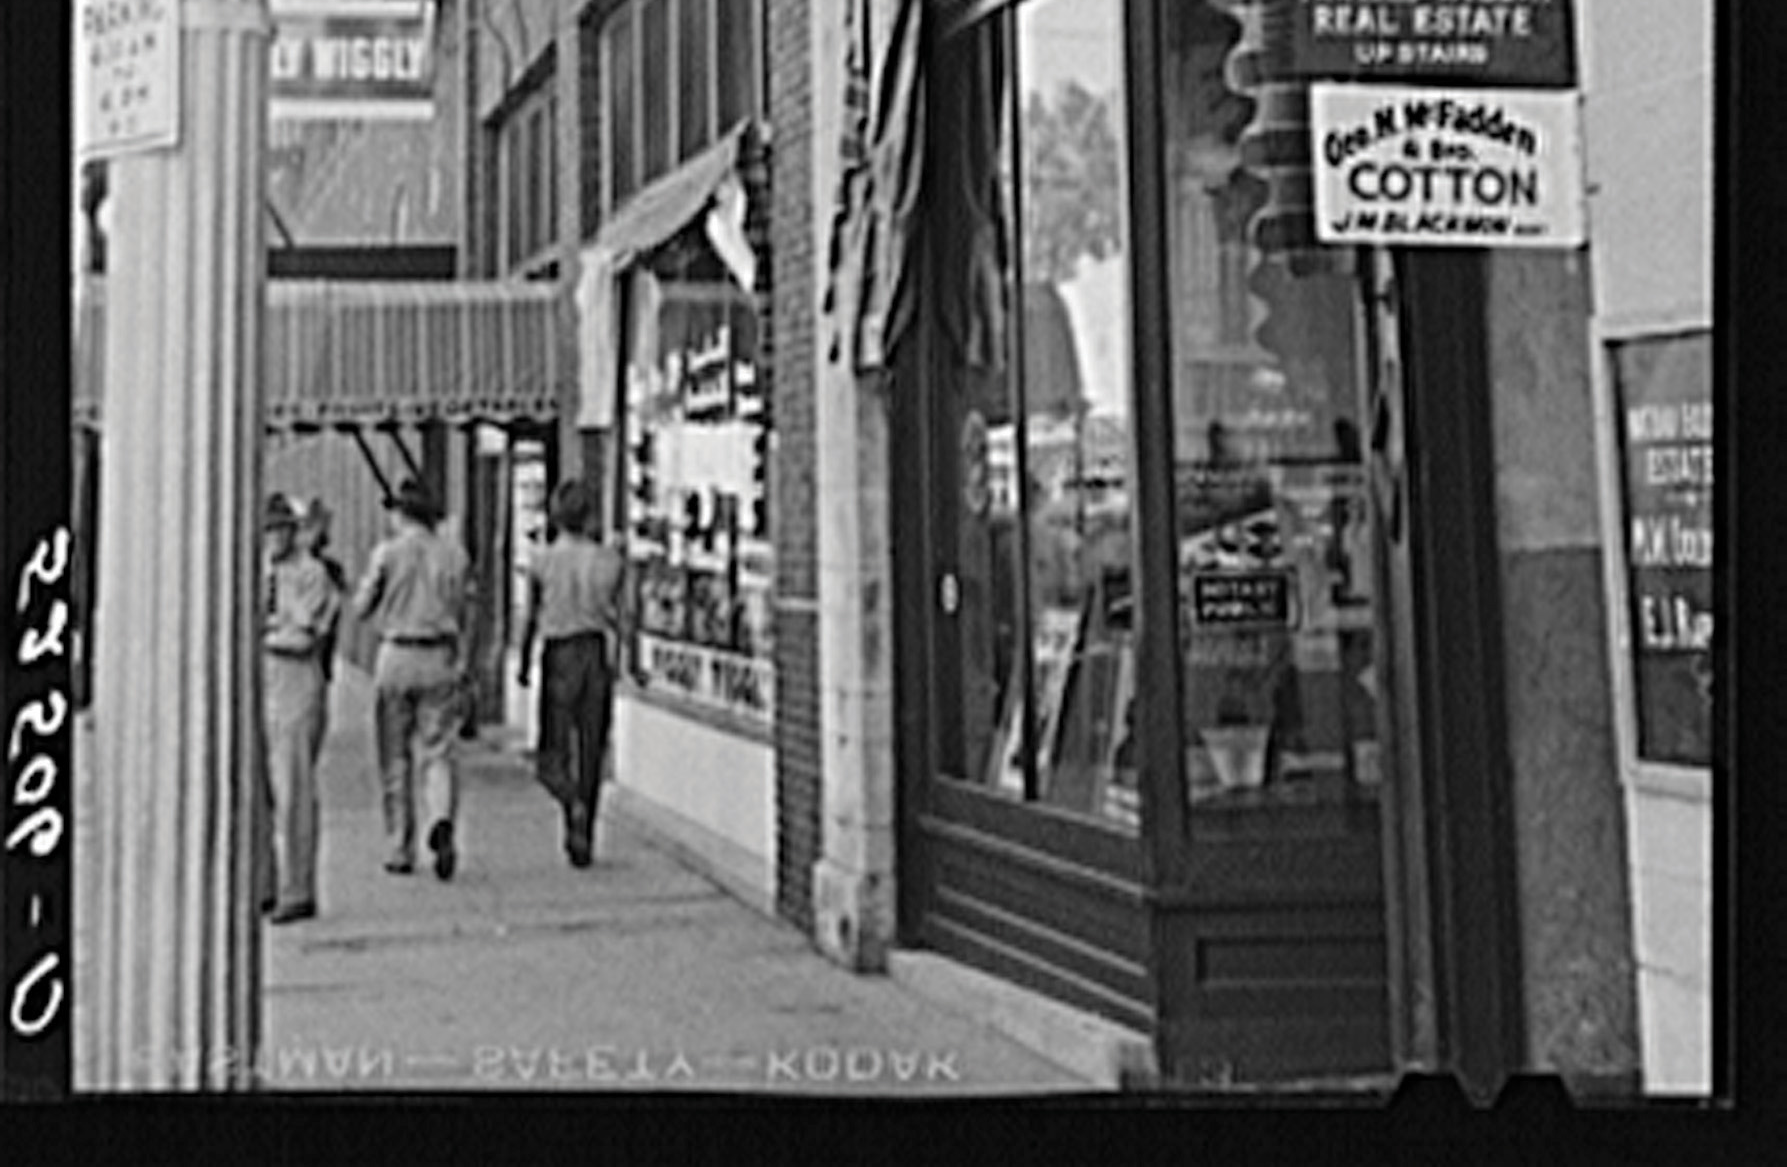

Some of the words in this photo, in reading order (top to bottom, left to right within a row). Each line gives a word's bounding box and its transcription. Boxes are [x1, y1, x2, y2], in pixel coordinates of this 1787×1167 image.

[1313, 5, 1399, 35] REAL
[1413, 4, 1532, 35] ESTATE
[314, 37, 423, 78] WIGGLY
[1349, 161, 1537, 206] COTTON
